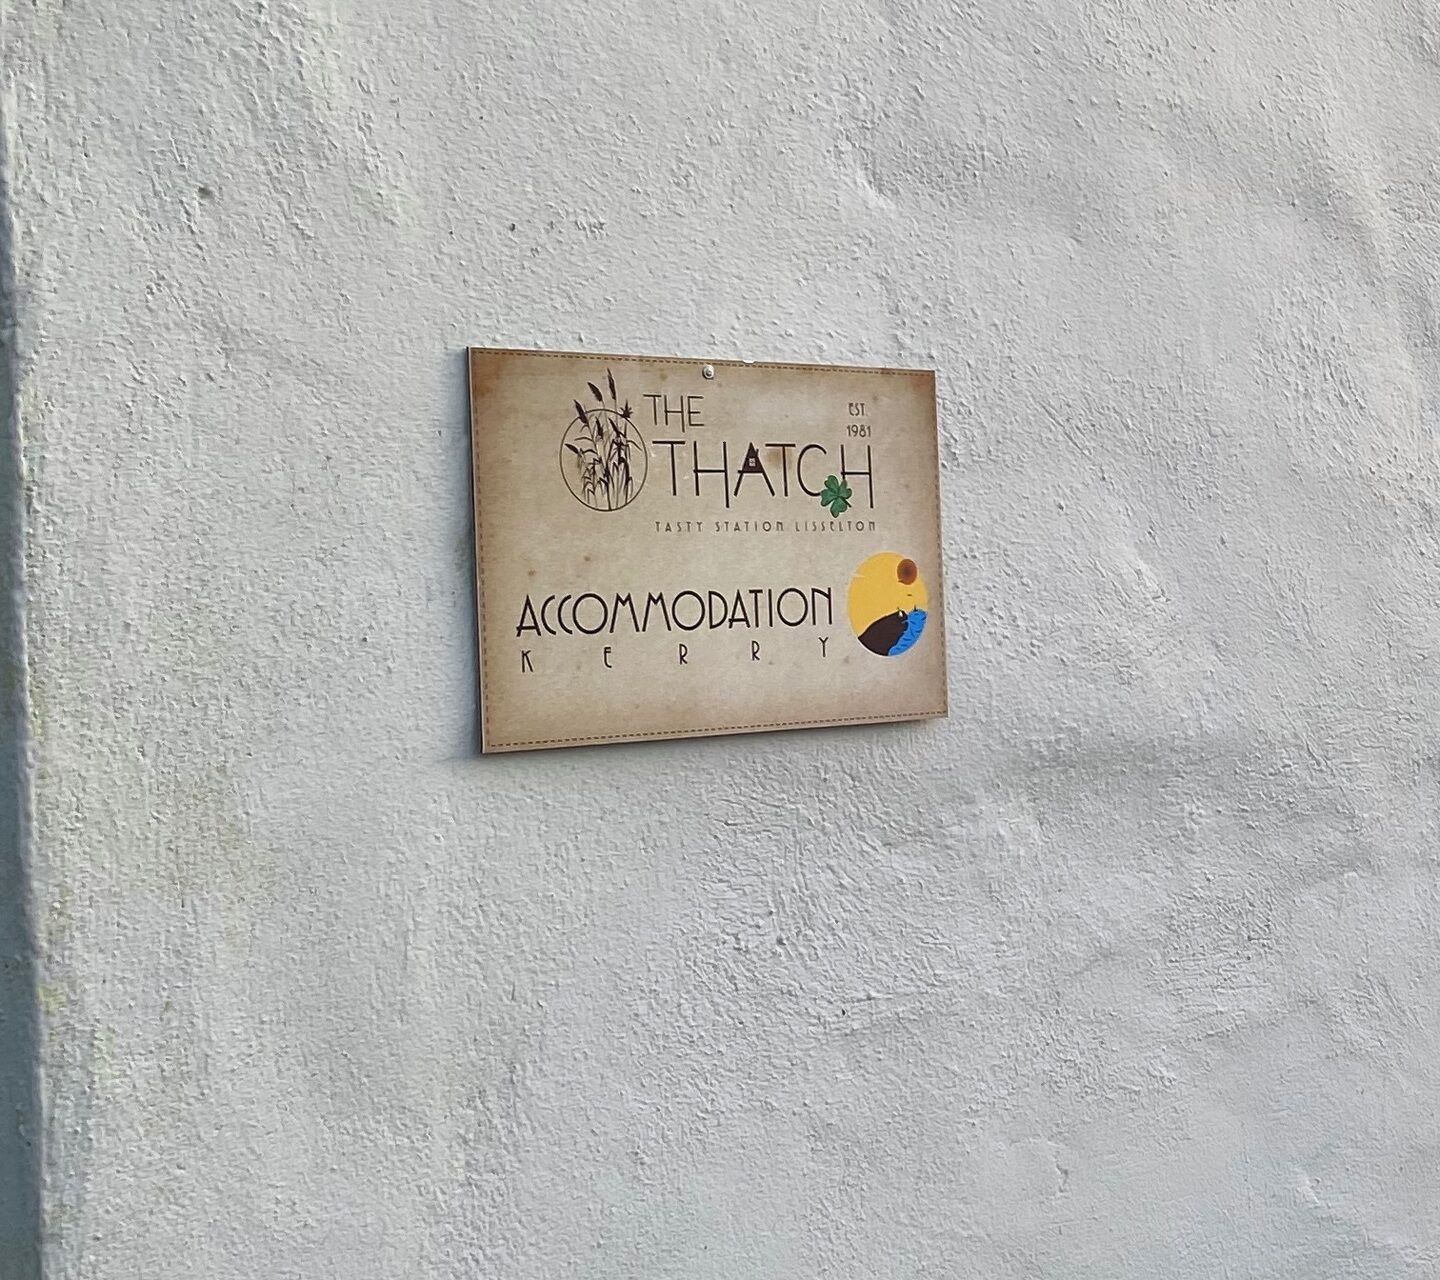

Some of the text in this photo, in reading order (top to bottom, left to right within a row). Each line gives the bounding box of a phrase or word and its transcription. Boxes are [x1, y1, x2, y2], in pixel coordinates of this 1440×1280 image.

[643, 393, 705, 433] THE
[846, 424, 871, 438] 1981
[652, 440, 875, 509] THATCH
[655, 520, 876, 533] TASTY STATION LISSELTON
[516, 587, 833, 637] ACCOMMODATION
[521, 636, 829, 673] KERRY
